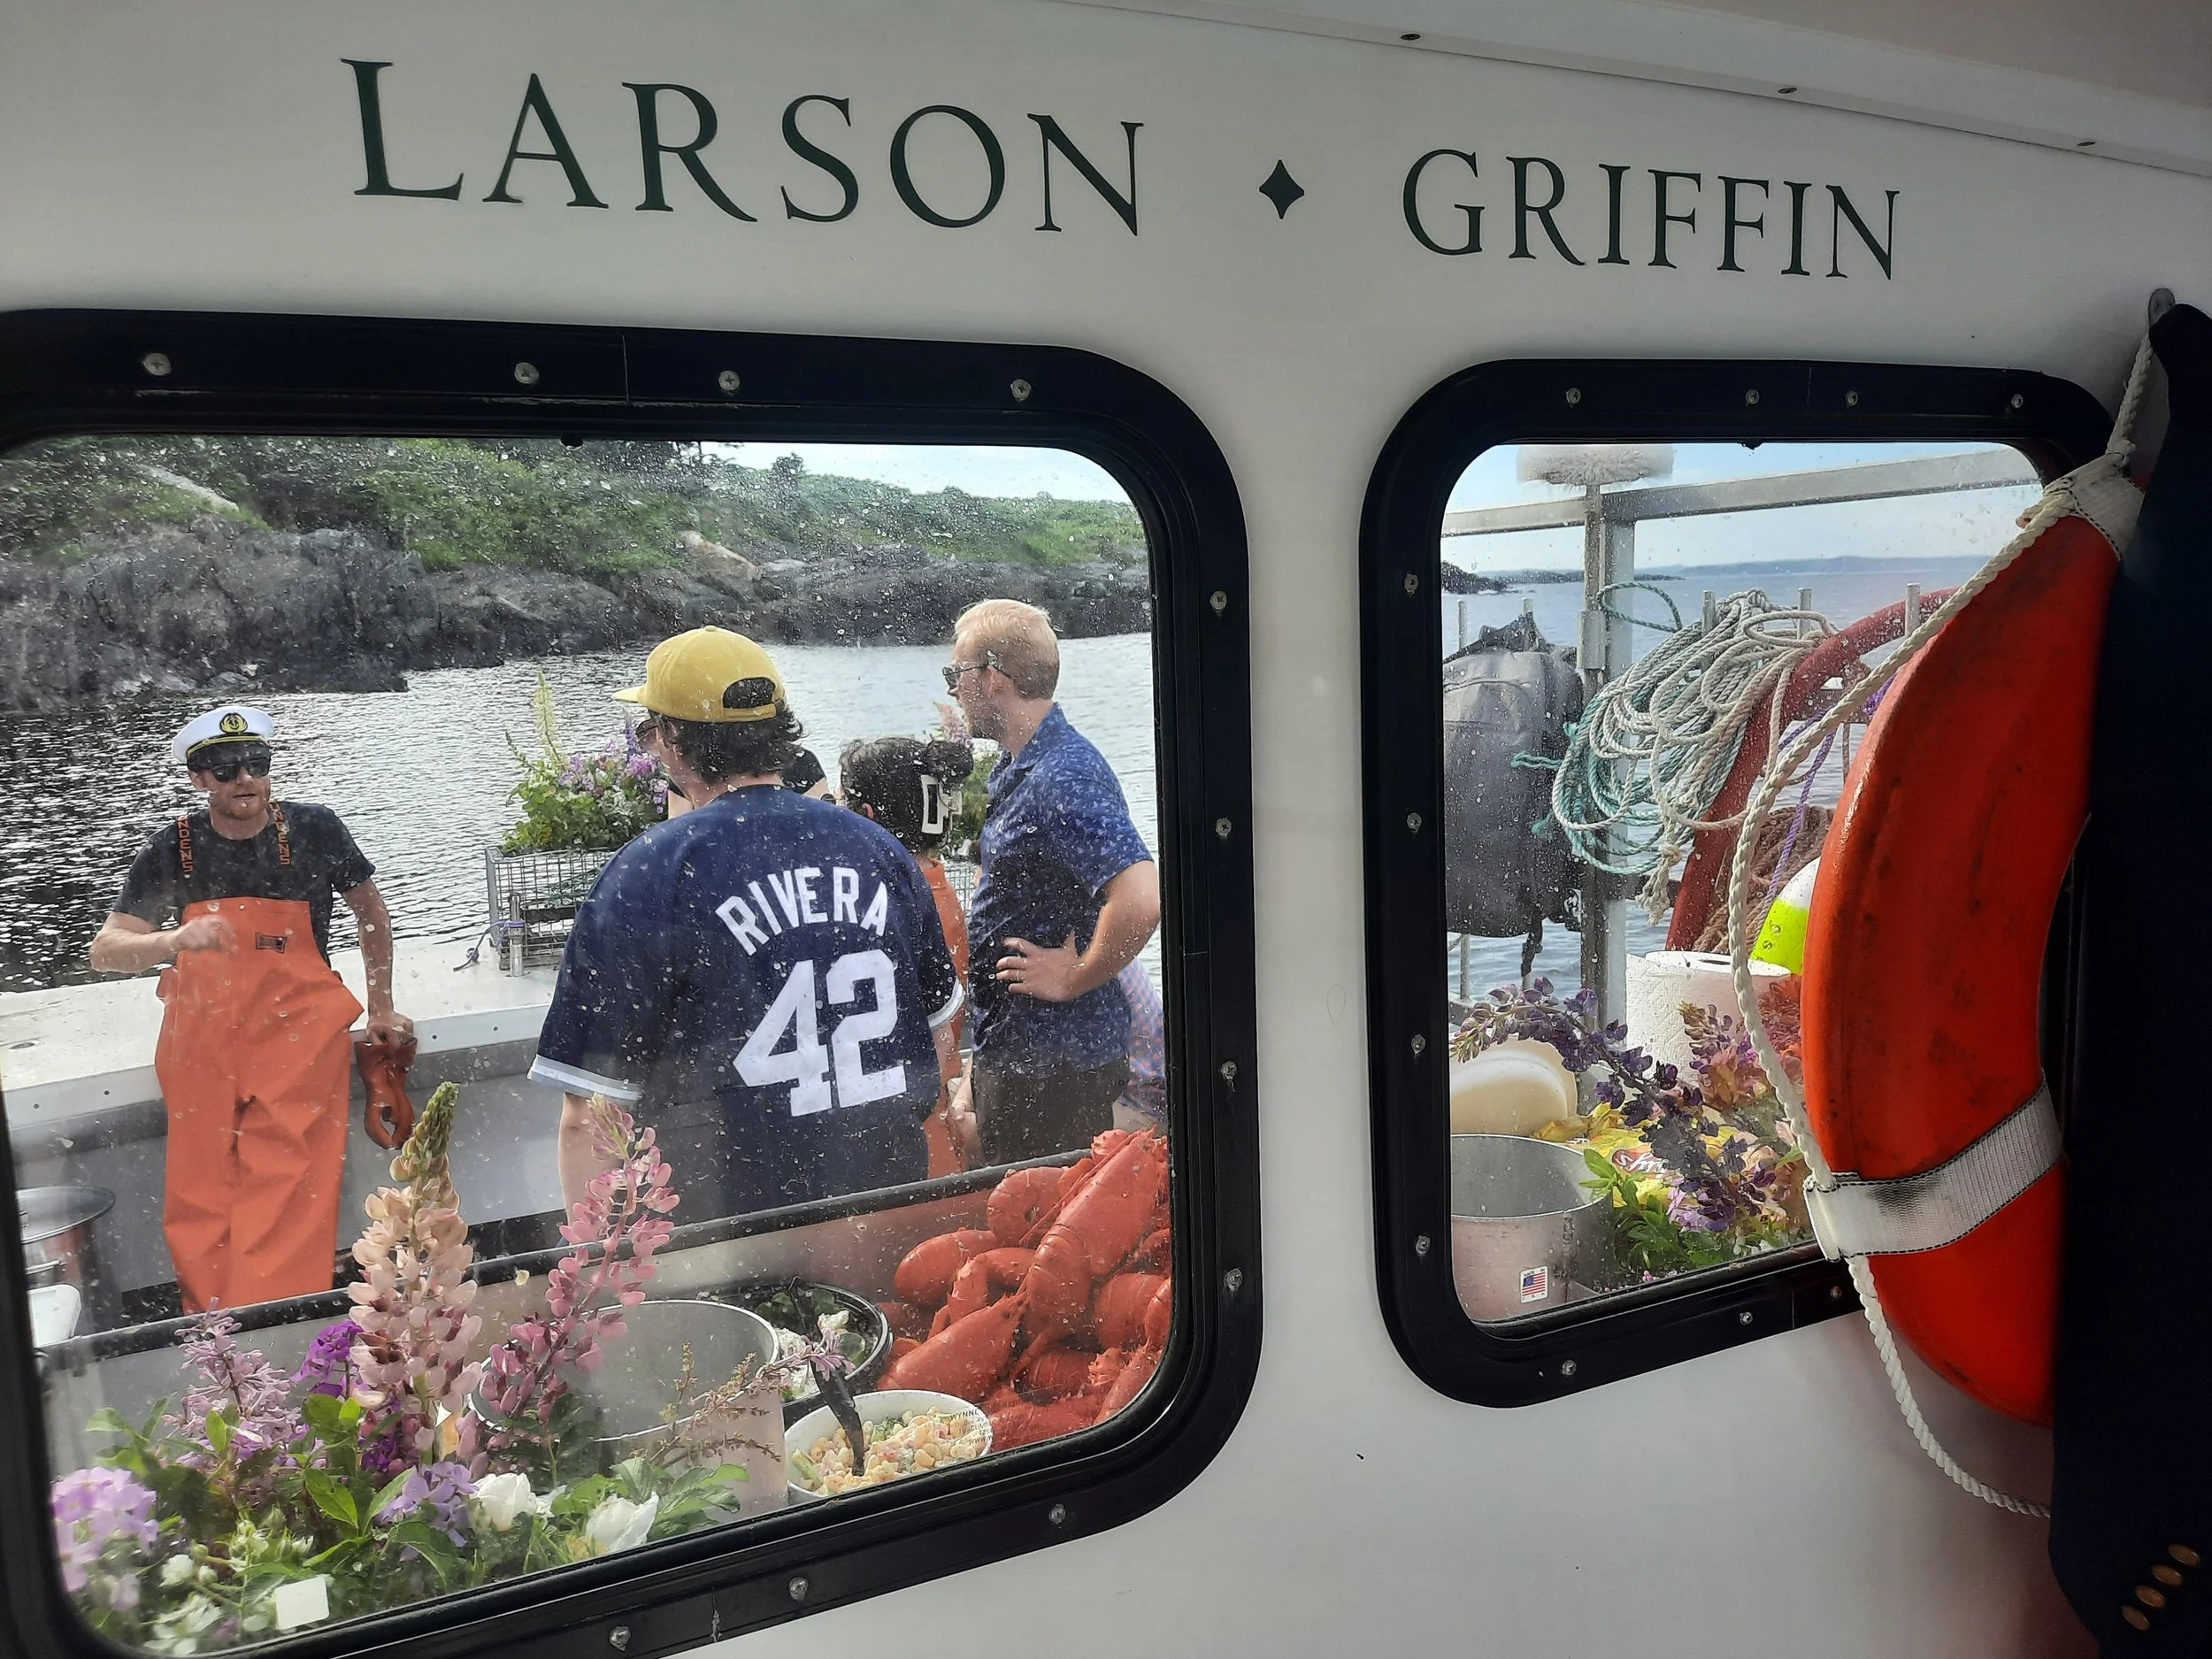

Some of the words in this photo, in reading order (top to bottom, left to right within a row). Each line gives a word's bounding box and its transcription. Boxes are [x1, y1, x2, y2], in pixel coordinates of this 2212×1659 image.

[341, 58, 1144, 236] LARSON
[1403, 150, 1900, 280] GRIFFIN
[715, 866, 888, 956] RIVERA
[733, 949, 908, 1118] 42
